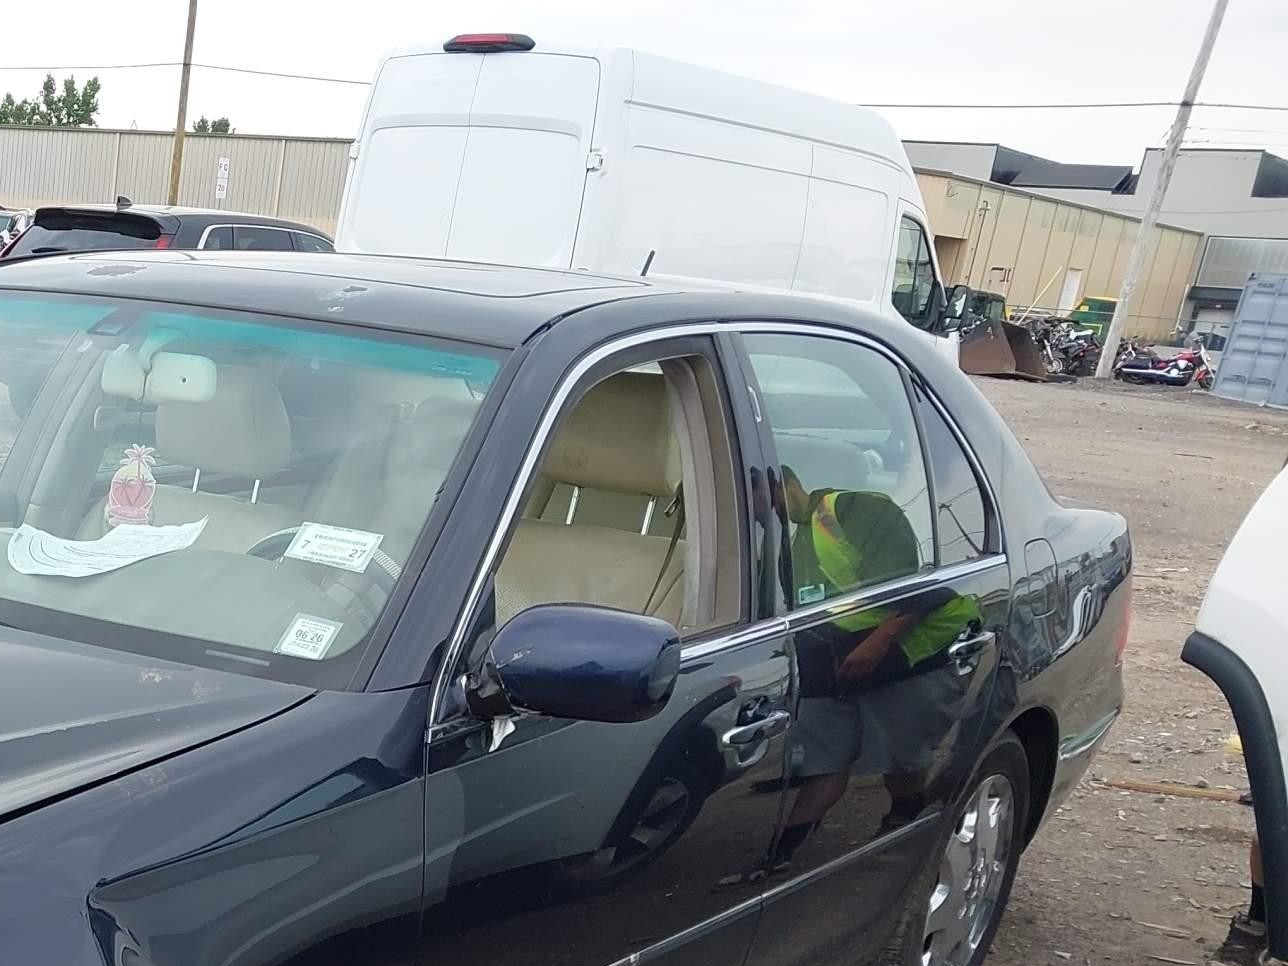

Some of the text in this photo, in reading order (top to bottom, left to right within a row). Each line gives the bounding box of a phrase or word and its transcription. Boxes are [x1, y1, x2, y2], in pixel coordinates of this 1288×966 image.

[301, 539, 311, 549] 7
[348, 548, 367, 559] 27
[296, 629, 309, 639] 06
[310, 632, 324, 642] 26
